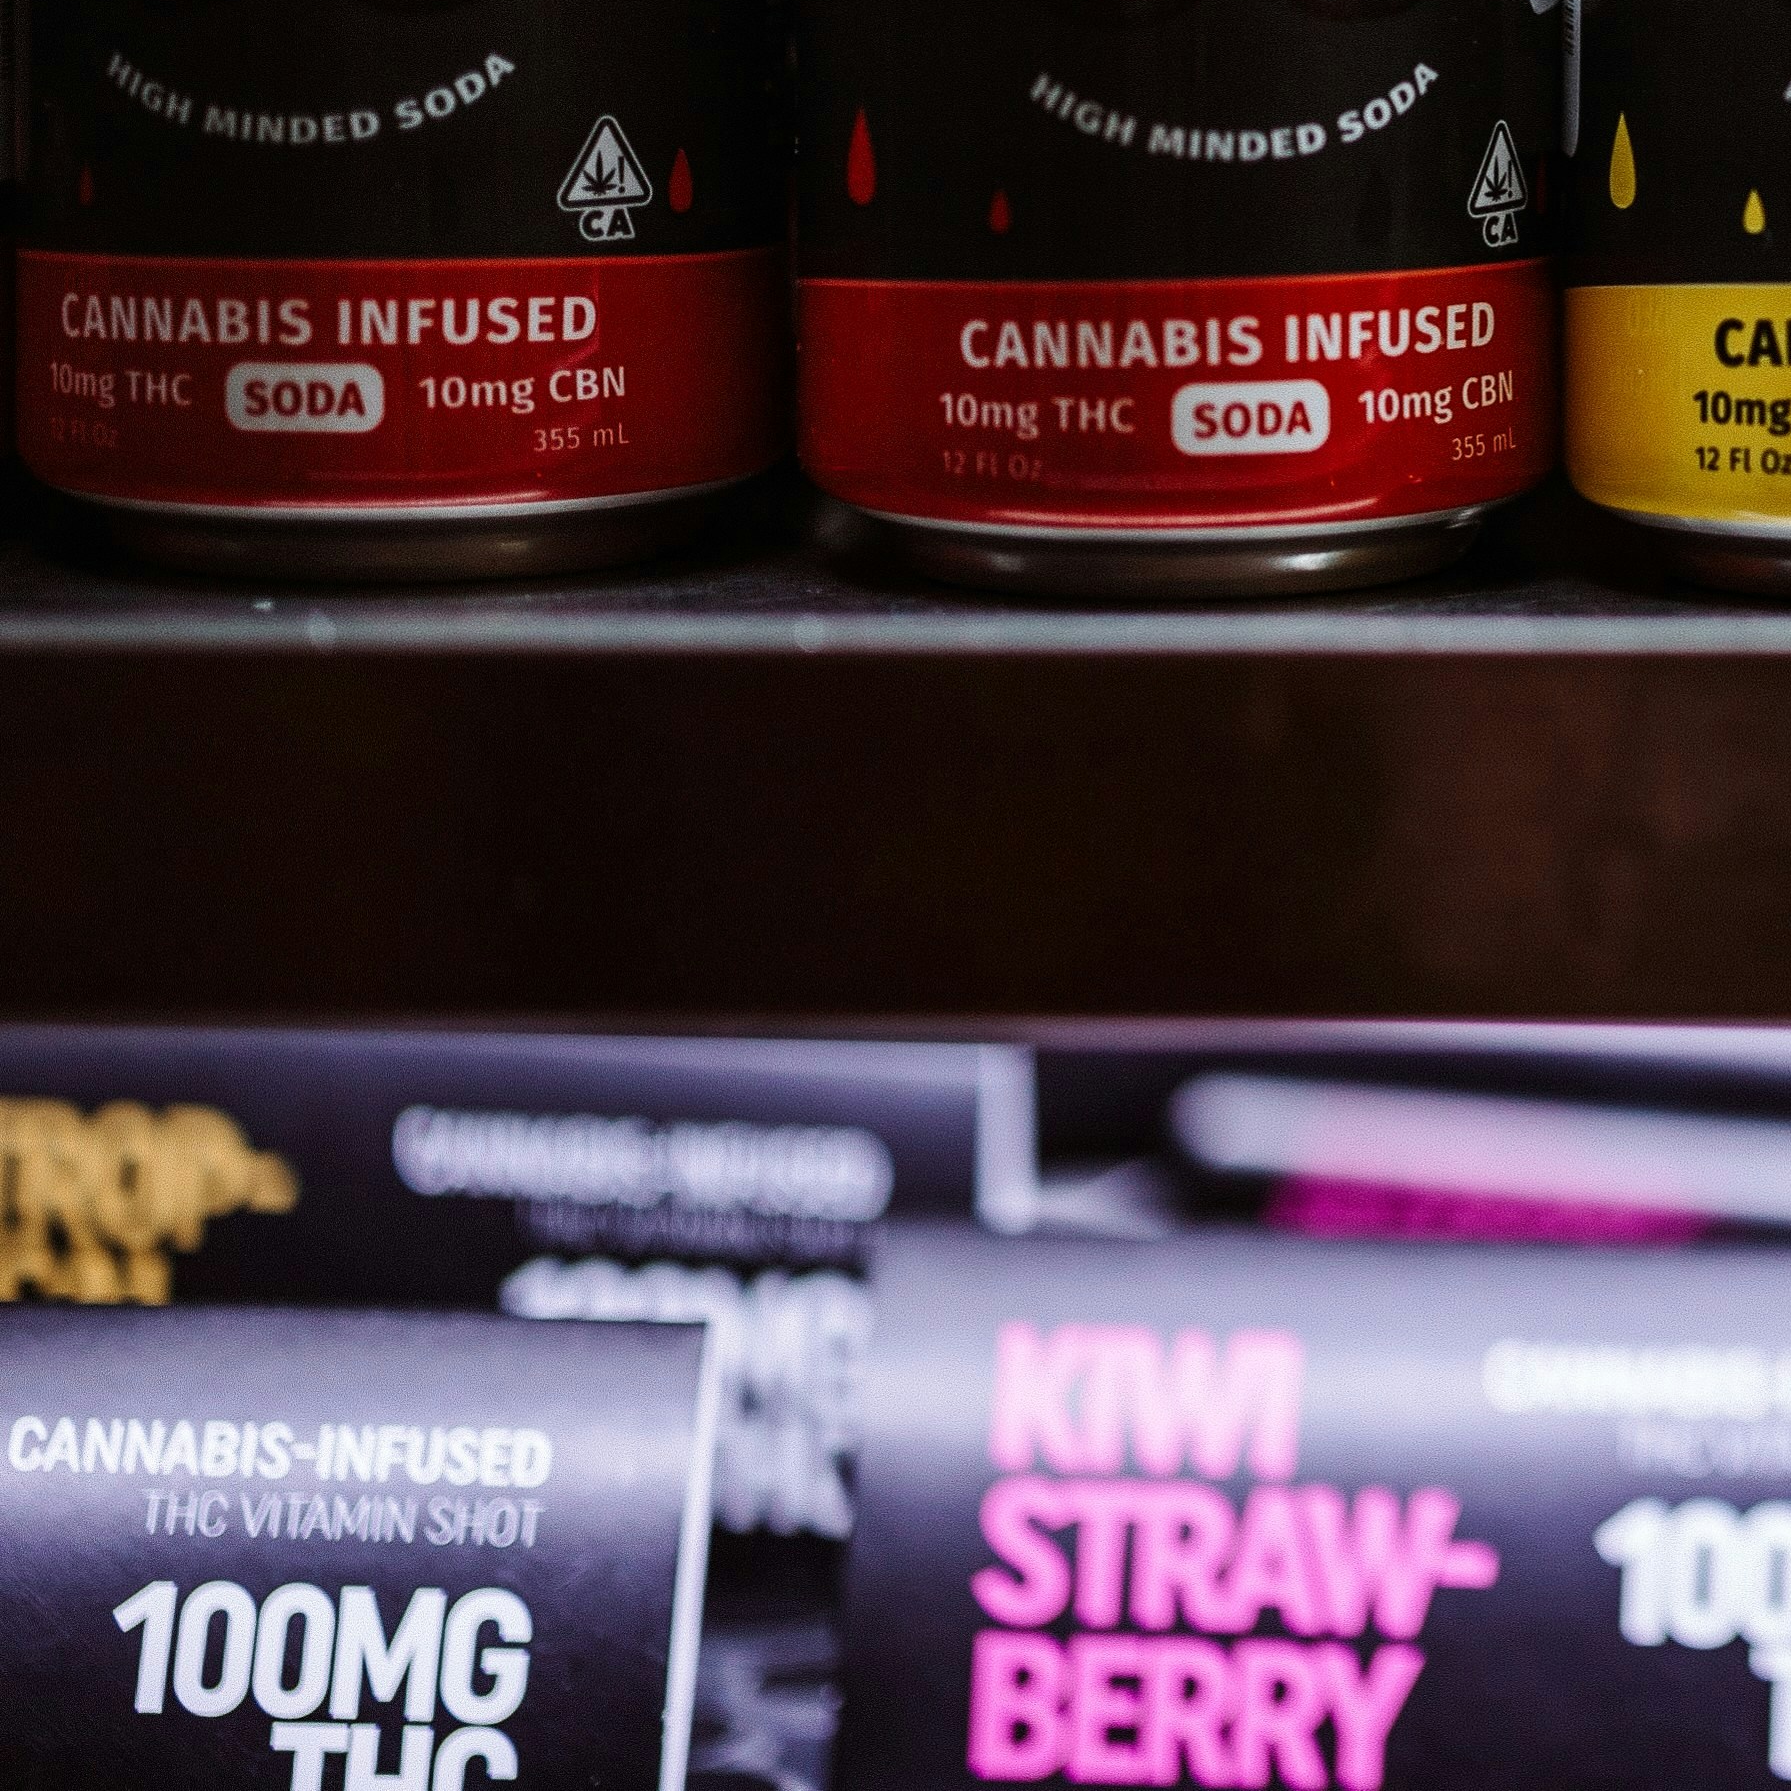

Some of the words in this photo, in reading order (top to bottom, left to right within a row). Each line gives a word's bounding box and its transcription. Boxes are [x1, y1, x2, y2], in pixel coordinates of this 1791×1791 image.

[107, 51, 194, 125] HIGH
[203, 105, 381, 146] MINDED
[395, 52, 516, 130] SODA
[1030, 72, 1138, 147] HIGH
[1148, 121, 1328, 162] MINDED
[1336, 62, 1439, 144] SODA
[61, 293, 313, 346] CANNABIS
[337, 295, 596, 346] INFUSED
[960, 315, 1263, 368] CANNABIS
[1285, 301, 1495, 364] INFUSED
[50, 361, 114, 408] 10mg
[125, 370, 193, 406] THC
[242, 380, 365, 418] SODA
[419, 375, 534, 413] 10mg
[548, 366, 625, 404] CBN
[939, 392, 1039, 441] 10mg
[1051, 397, 1136, 433] THC
[1193, 400, 1314, 440] SODA
[1359, 386, 1453, 425] 10mg
[1462, 370, 1514, 411] CBN
[533, 426, 580, 452] 355
[593, 422, 629, 447] mL
[1451, 433, 1486, 461] 355
[1493, 428, 1517, 455] mL
[1695, 446, 1720, 471] 12
[1730, 447, 1751, 472] Fl
[987, 1320, 1303, 1478] KIWI
[7, 1414, 554, 1490] CANNABIS-INFUSED
[143, 1486, 227, 1540] THC
[239, 1490, 420, 1545] VITAMIN
[427, 1494, 546, 1550] SHOT
[972, 1473, 1500, 1639] STRAW-
[112, 1579, 534, 1725] 100MG
[967, 1628, 1425, 1789] BERRY
